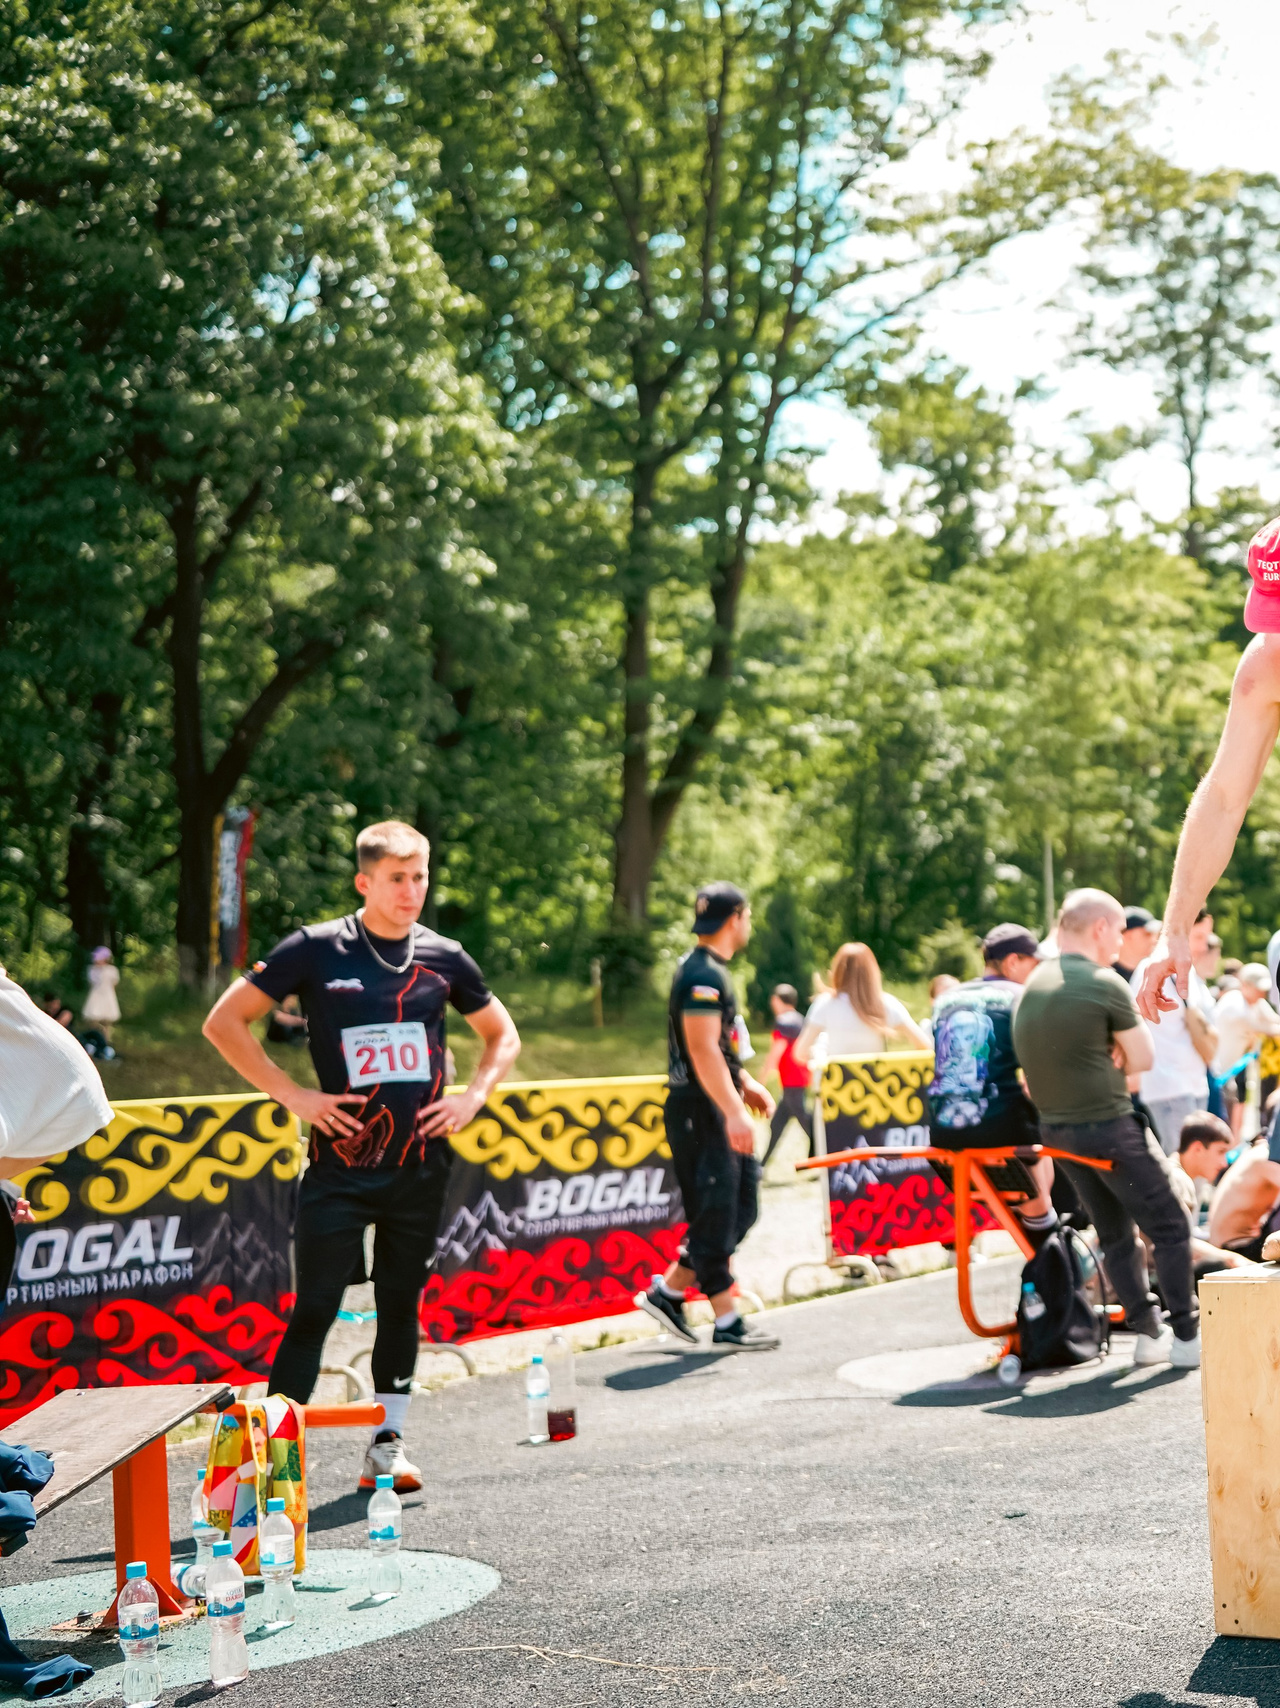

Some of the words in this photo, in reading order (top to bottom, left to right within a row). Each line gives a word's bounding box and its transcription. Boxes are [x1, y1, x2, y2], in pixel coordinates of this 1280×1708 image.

[356, 1042, 420, 1075] 210
[525, 1167, 671, 1220] BOGAL
[17, 1215, 195, 1282] OGAL
[6, 1275, 99, 1306] РТИВНЫЙ
[102, 1262, 194, 1292] МАРАФОН
